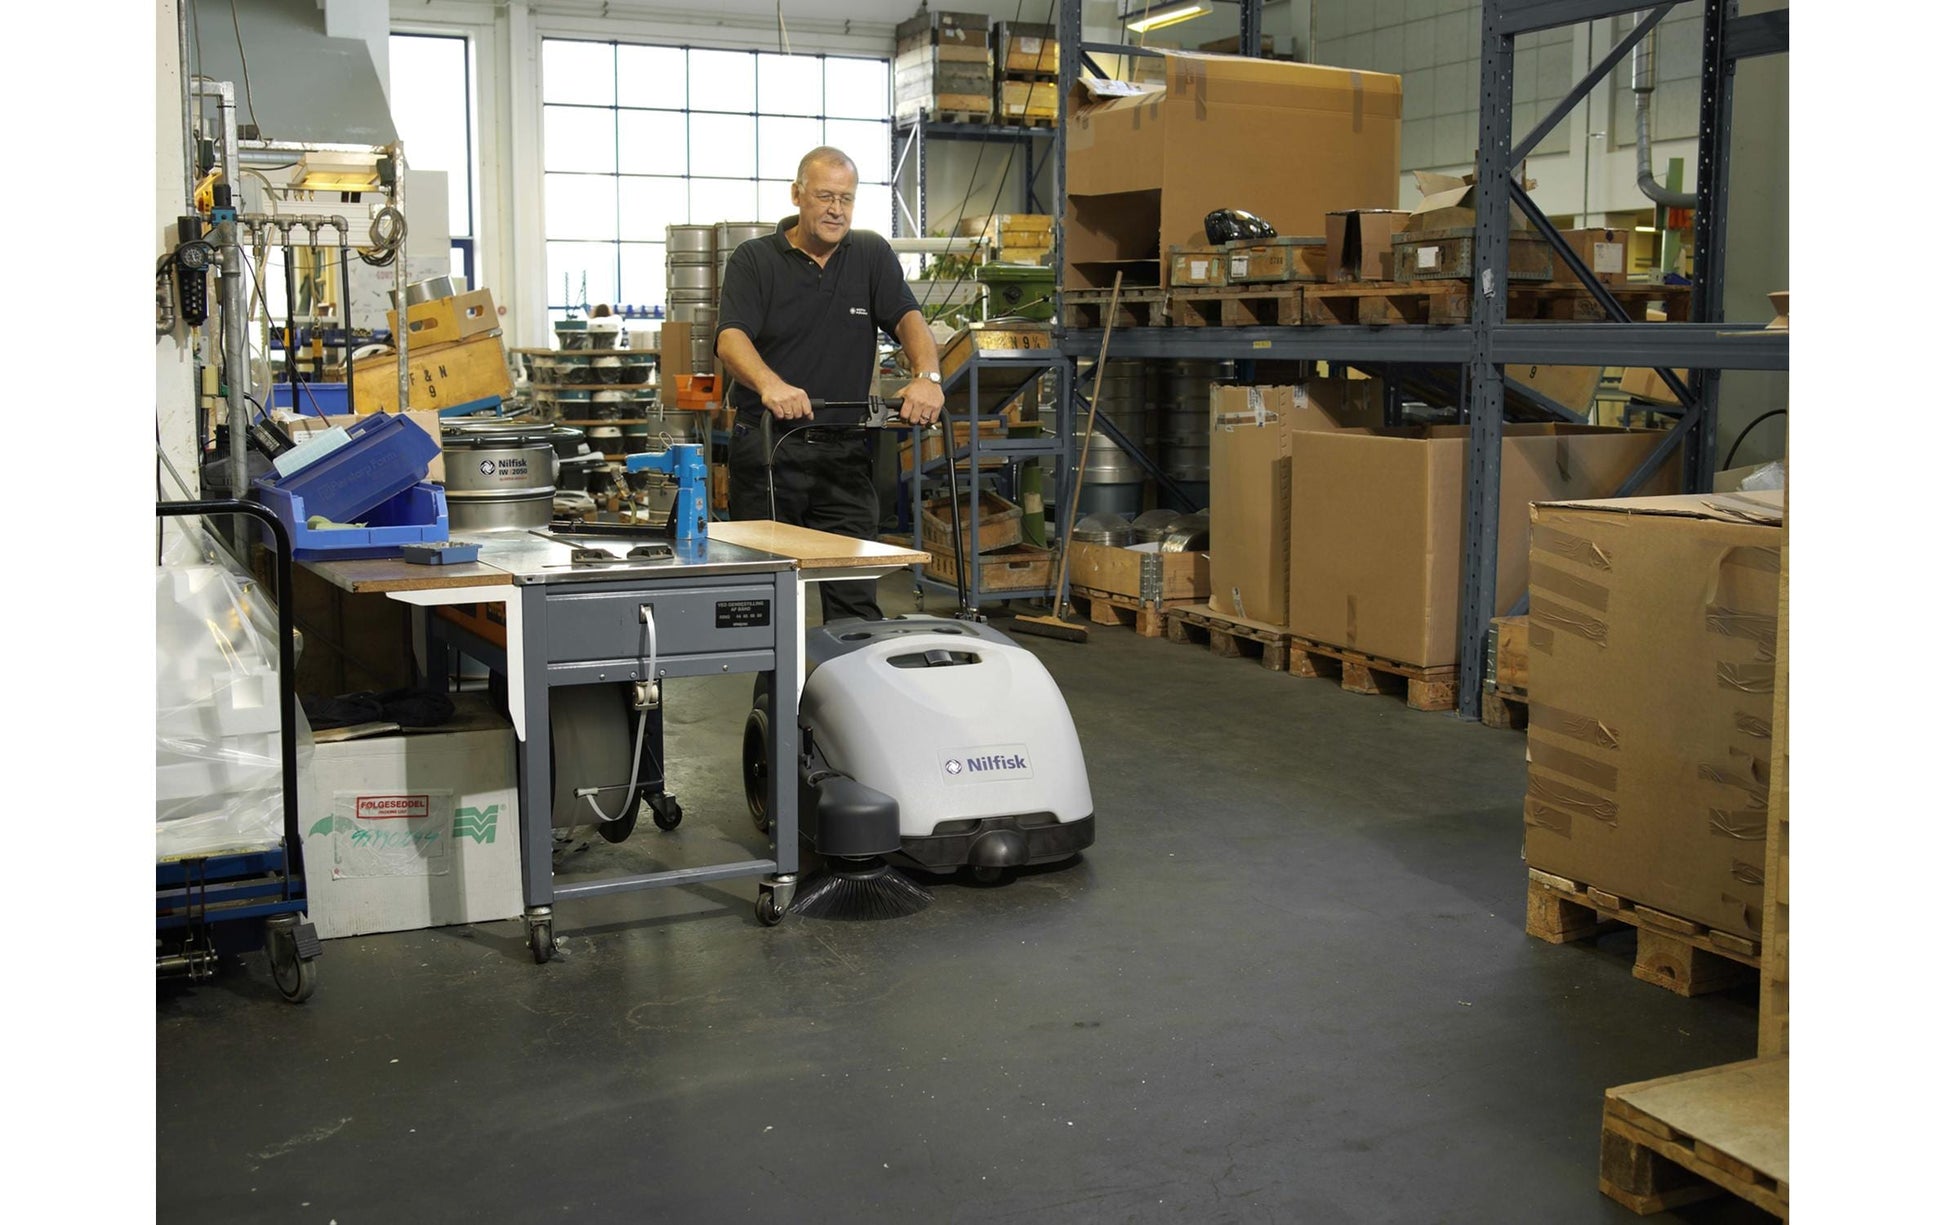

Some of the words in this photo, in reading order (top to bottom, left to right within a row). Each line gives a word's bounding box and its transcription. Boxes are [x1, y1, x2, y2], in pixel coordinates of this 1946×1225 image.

[1023, 335, 1030, 350] 9
[409, 372, 415, 386] F
[424, 369, 432, 382] &
[438, 364, 448, 379] N
[1529, 366, 1537, 379] 9
[429, 384, 437, 398] 9
[498, 458, 528, 468] Nilfisk
[967, 755, 1027, 772] Nilfisk
